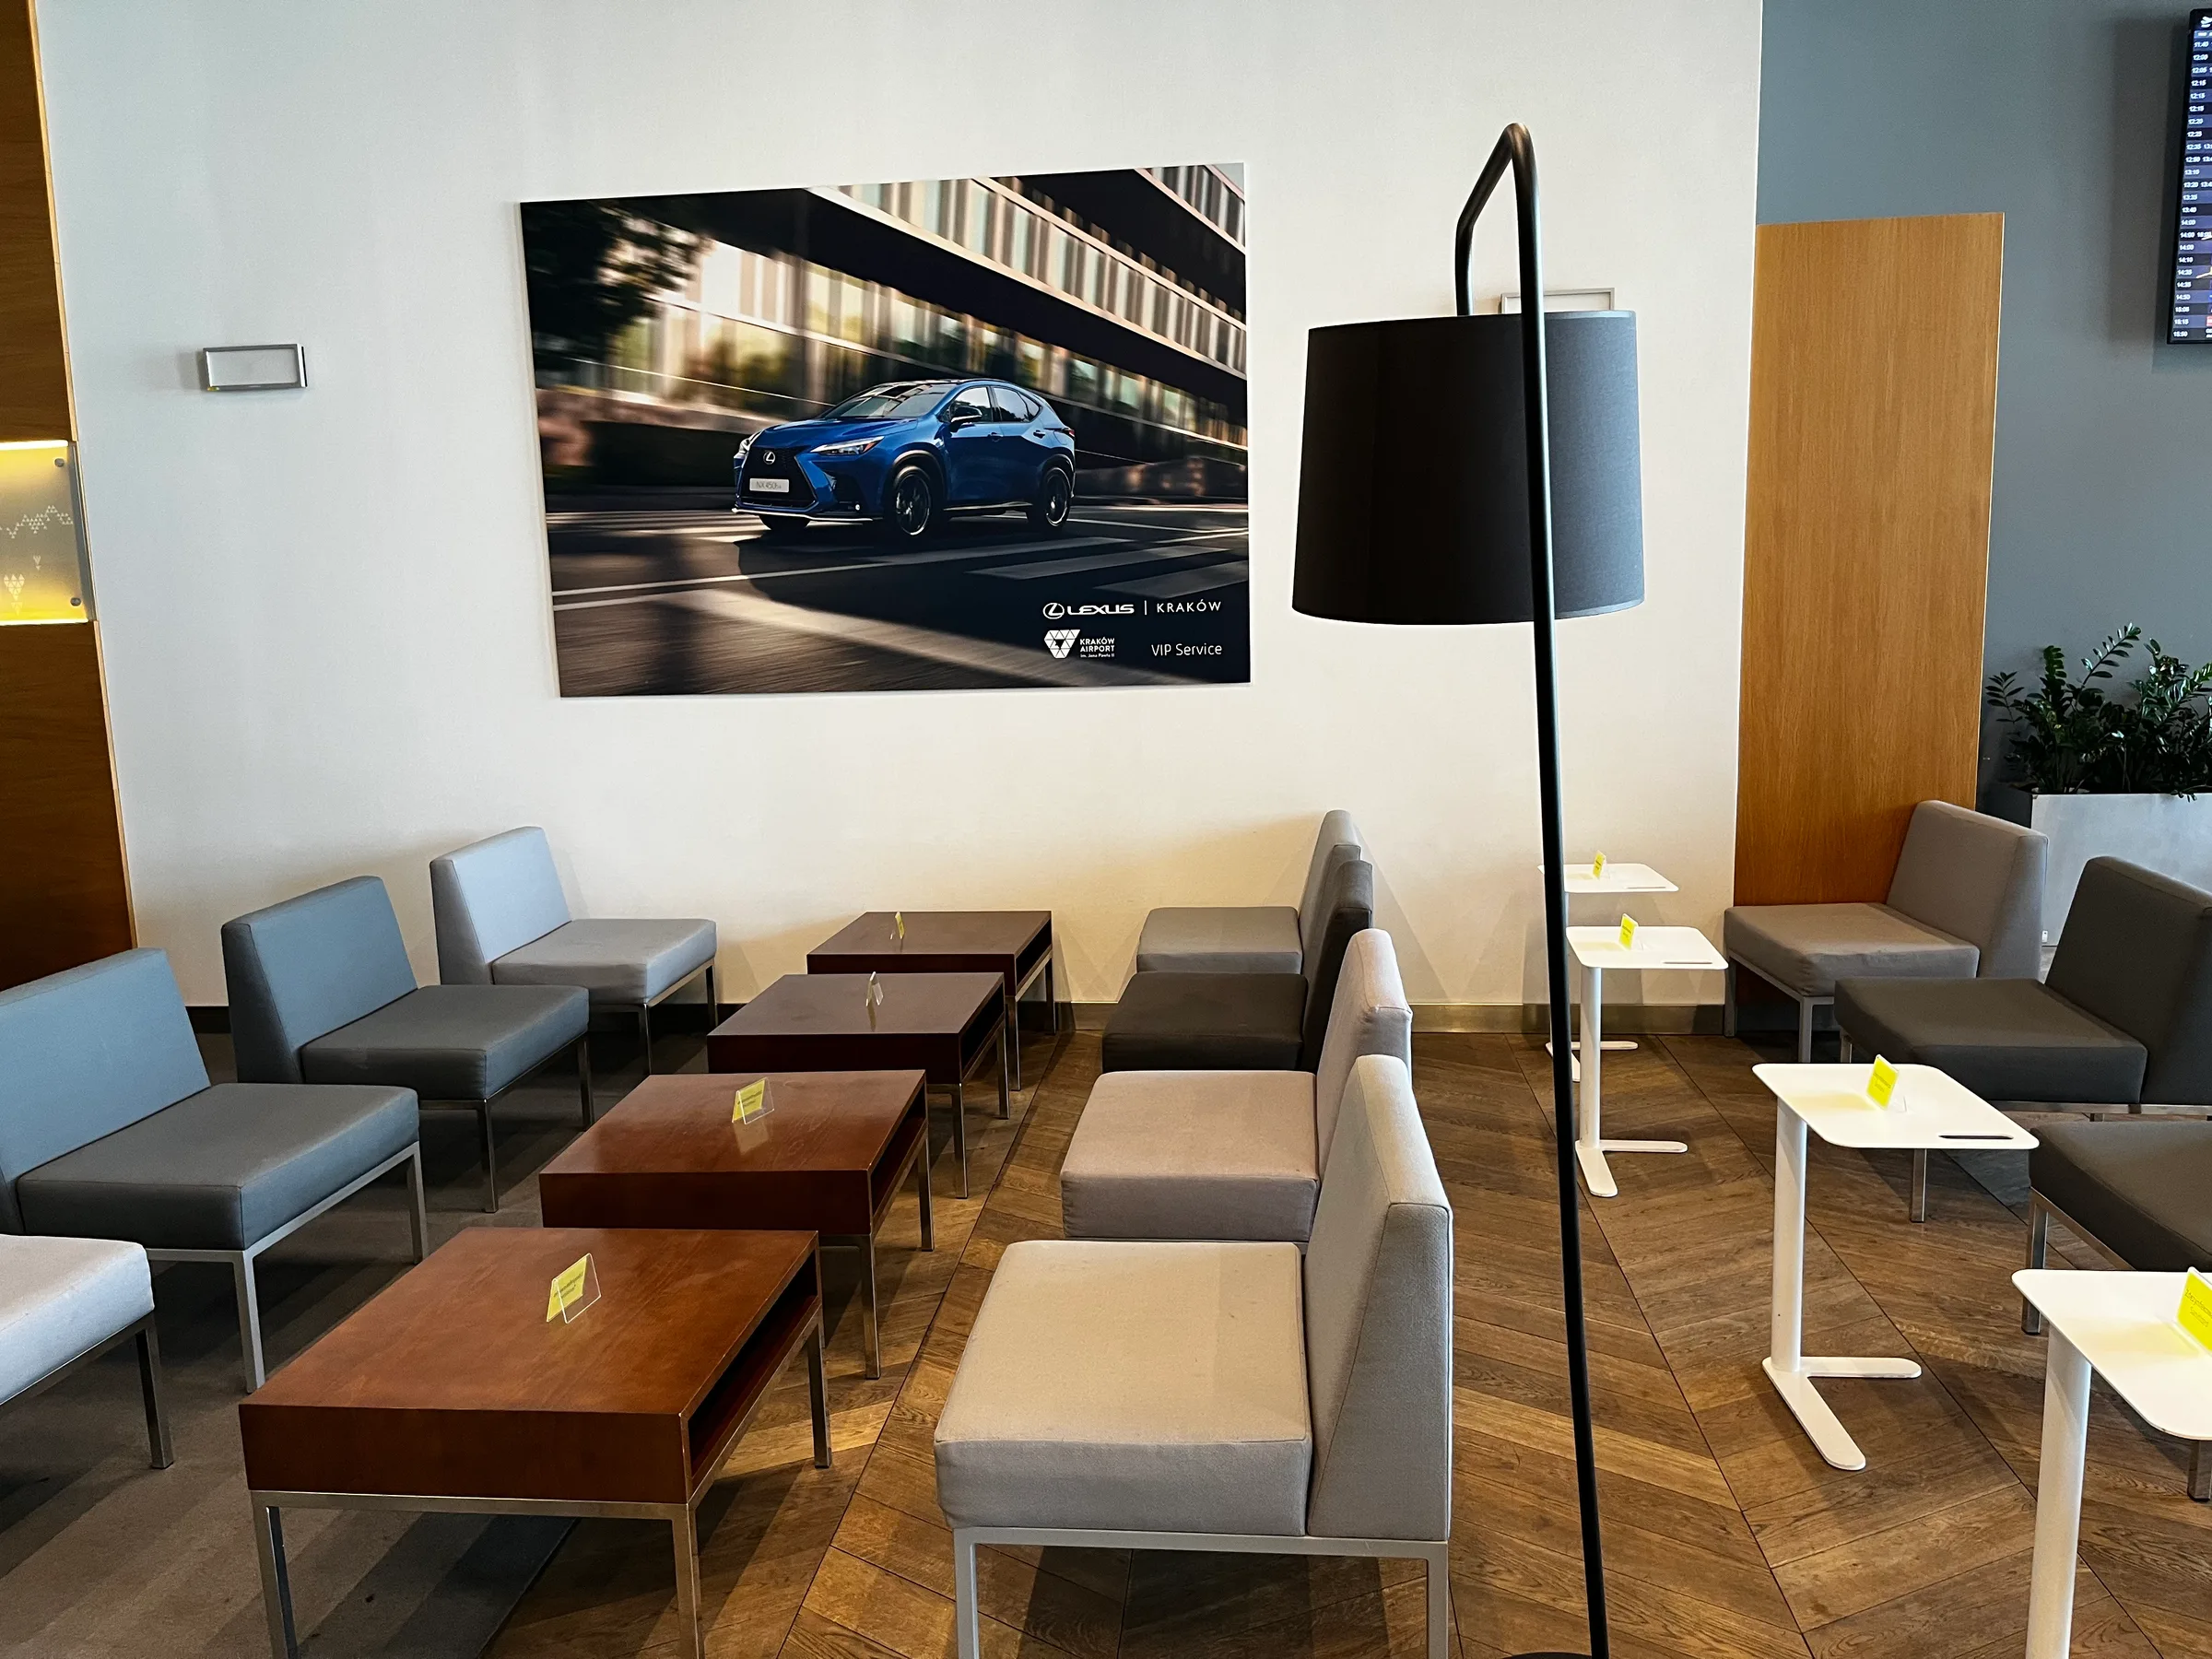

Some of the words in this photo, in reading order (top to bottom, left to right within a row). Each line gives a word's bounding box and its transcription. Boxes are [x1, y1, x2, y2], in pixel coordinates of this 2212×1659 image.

[1066, 604, 1135, 615] LEXUS
[1157, 599, 1221, 613] KRAKÓW
[1079, 636, 1115, 645] KRAKÓW
[1151, 644, 1171, 655] VIP
[1176, 643, 1222, 655] Service
